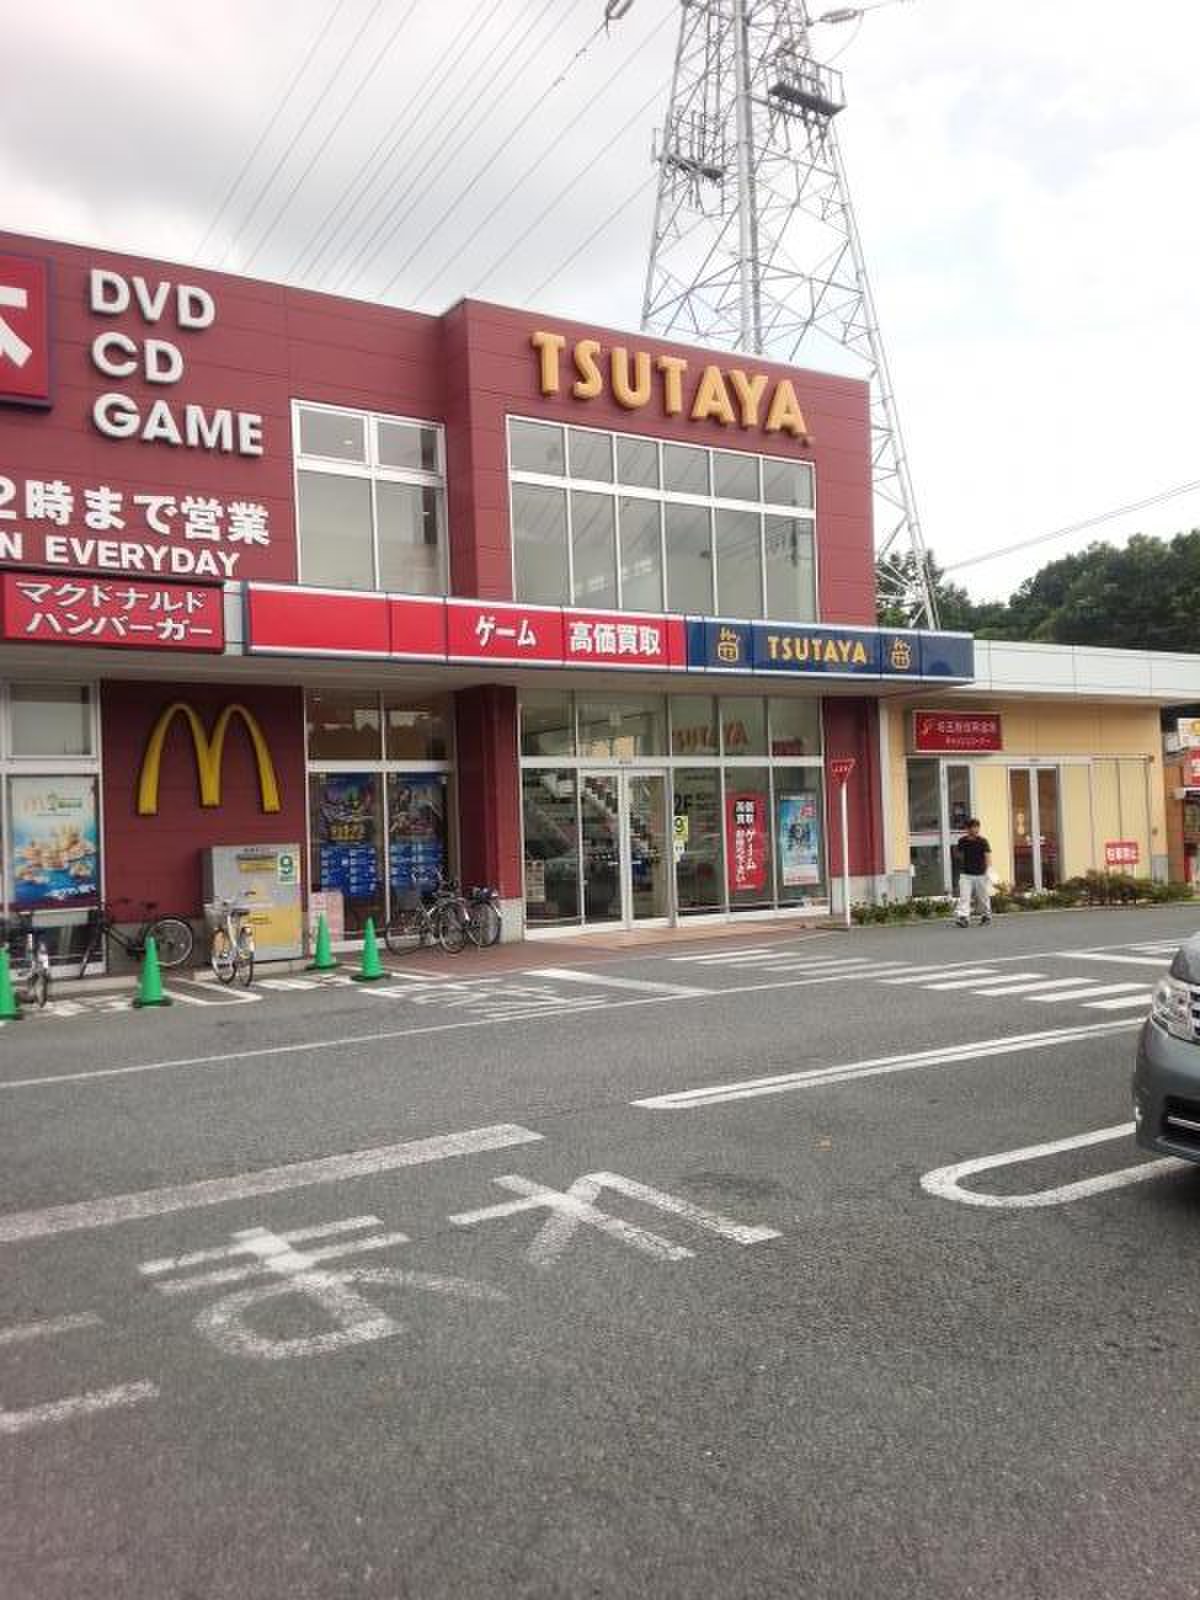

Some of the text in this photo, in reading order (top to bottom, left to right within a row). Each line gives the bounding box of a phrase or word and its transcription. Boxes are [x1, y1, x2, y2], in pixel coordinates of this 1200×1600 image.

[91, 269, 215, 328] DVD
[92, 332, 184, 383] CD
[531, 331, 810, 440] TSUTAYA
[93, 393, 263, 455] GAME
[46, 535, 240, 577] EVERYDAY
[16, 581, 208, 613] マクドナルド
[26, 612, 213, 641] ハンバーガー
[475, 615, 661, 655] ゲーム 高価買取
[767, 635, 867, 665] TSUTAYA
[280, 854, 293, 875] 9
